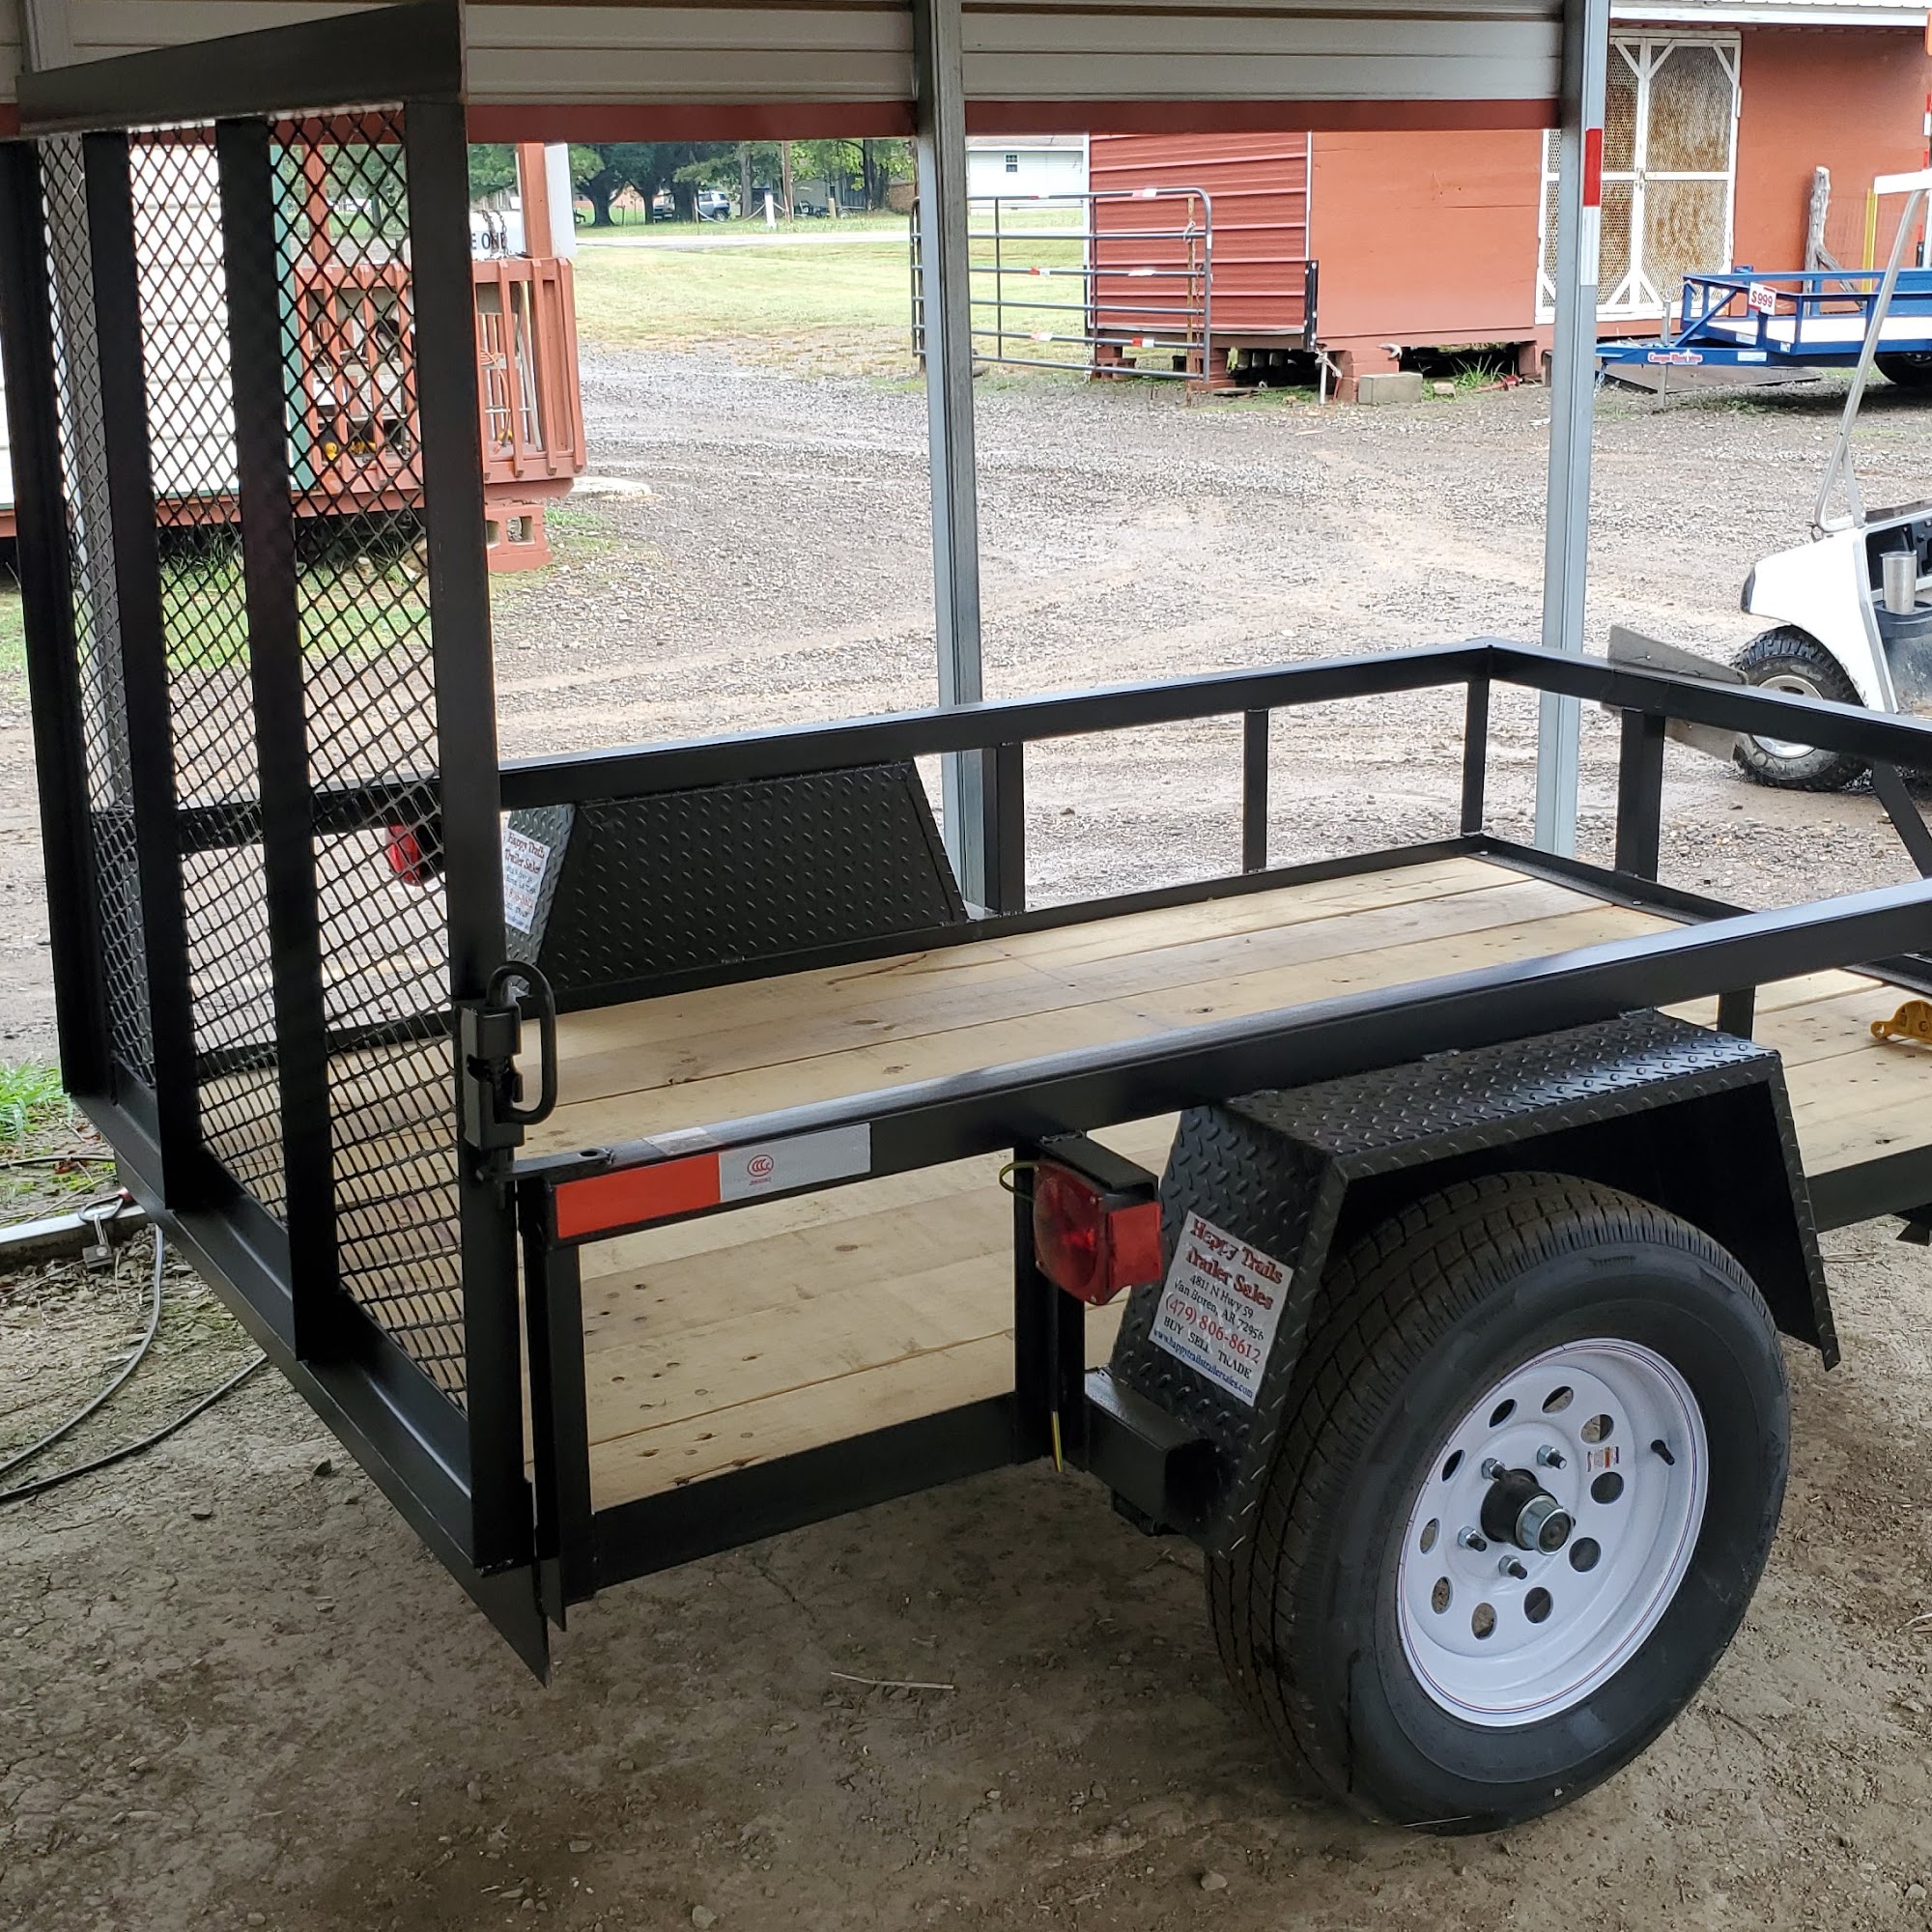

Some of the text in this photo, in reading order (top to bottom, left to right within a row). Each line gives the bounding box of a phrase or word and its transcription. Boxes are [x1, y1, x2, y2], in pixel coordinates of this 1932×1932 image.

[1751, 290, 1773, 307] $999
[1185, 1245, 1274, 1310] Trailer Sales
[1190, 1217, 1284, 1285] Happy Trails
[1174, 1278, 1264, 1341] Van Buren, AR 72956
[1189, 1274, 1254, 1319] 4811 N Hwy 59
[1163, 1316, 1253, 1380] BUY SELL TRADE
[1165, 1293, 1262, 1365] (479) 806-8612
